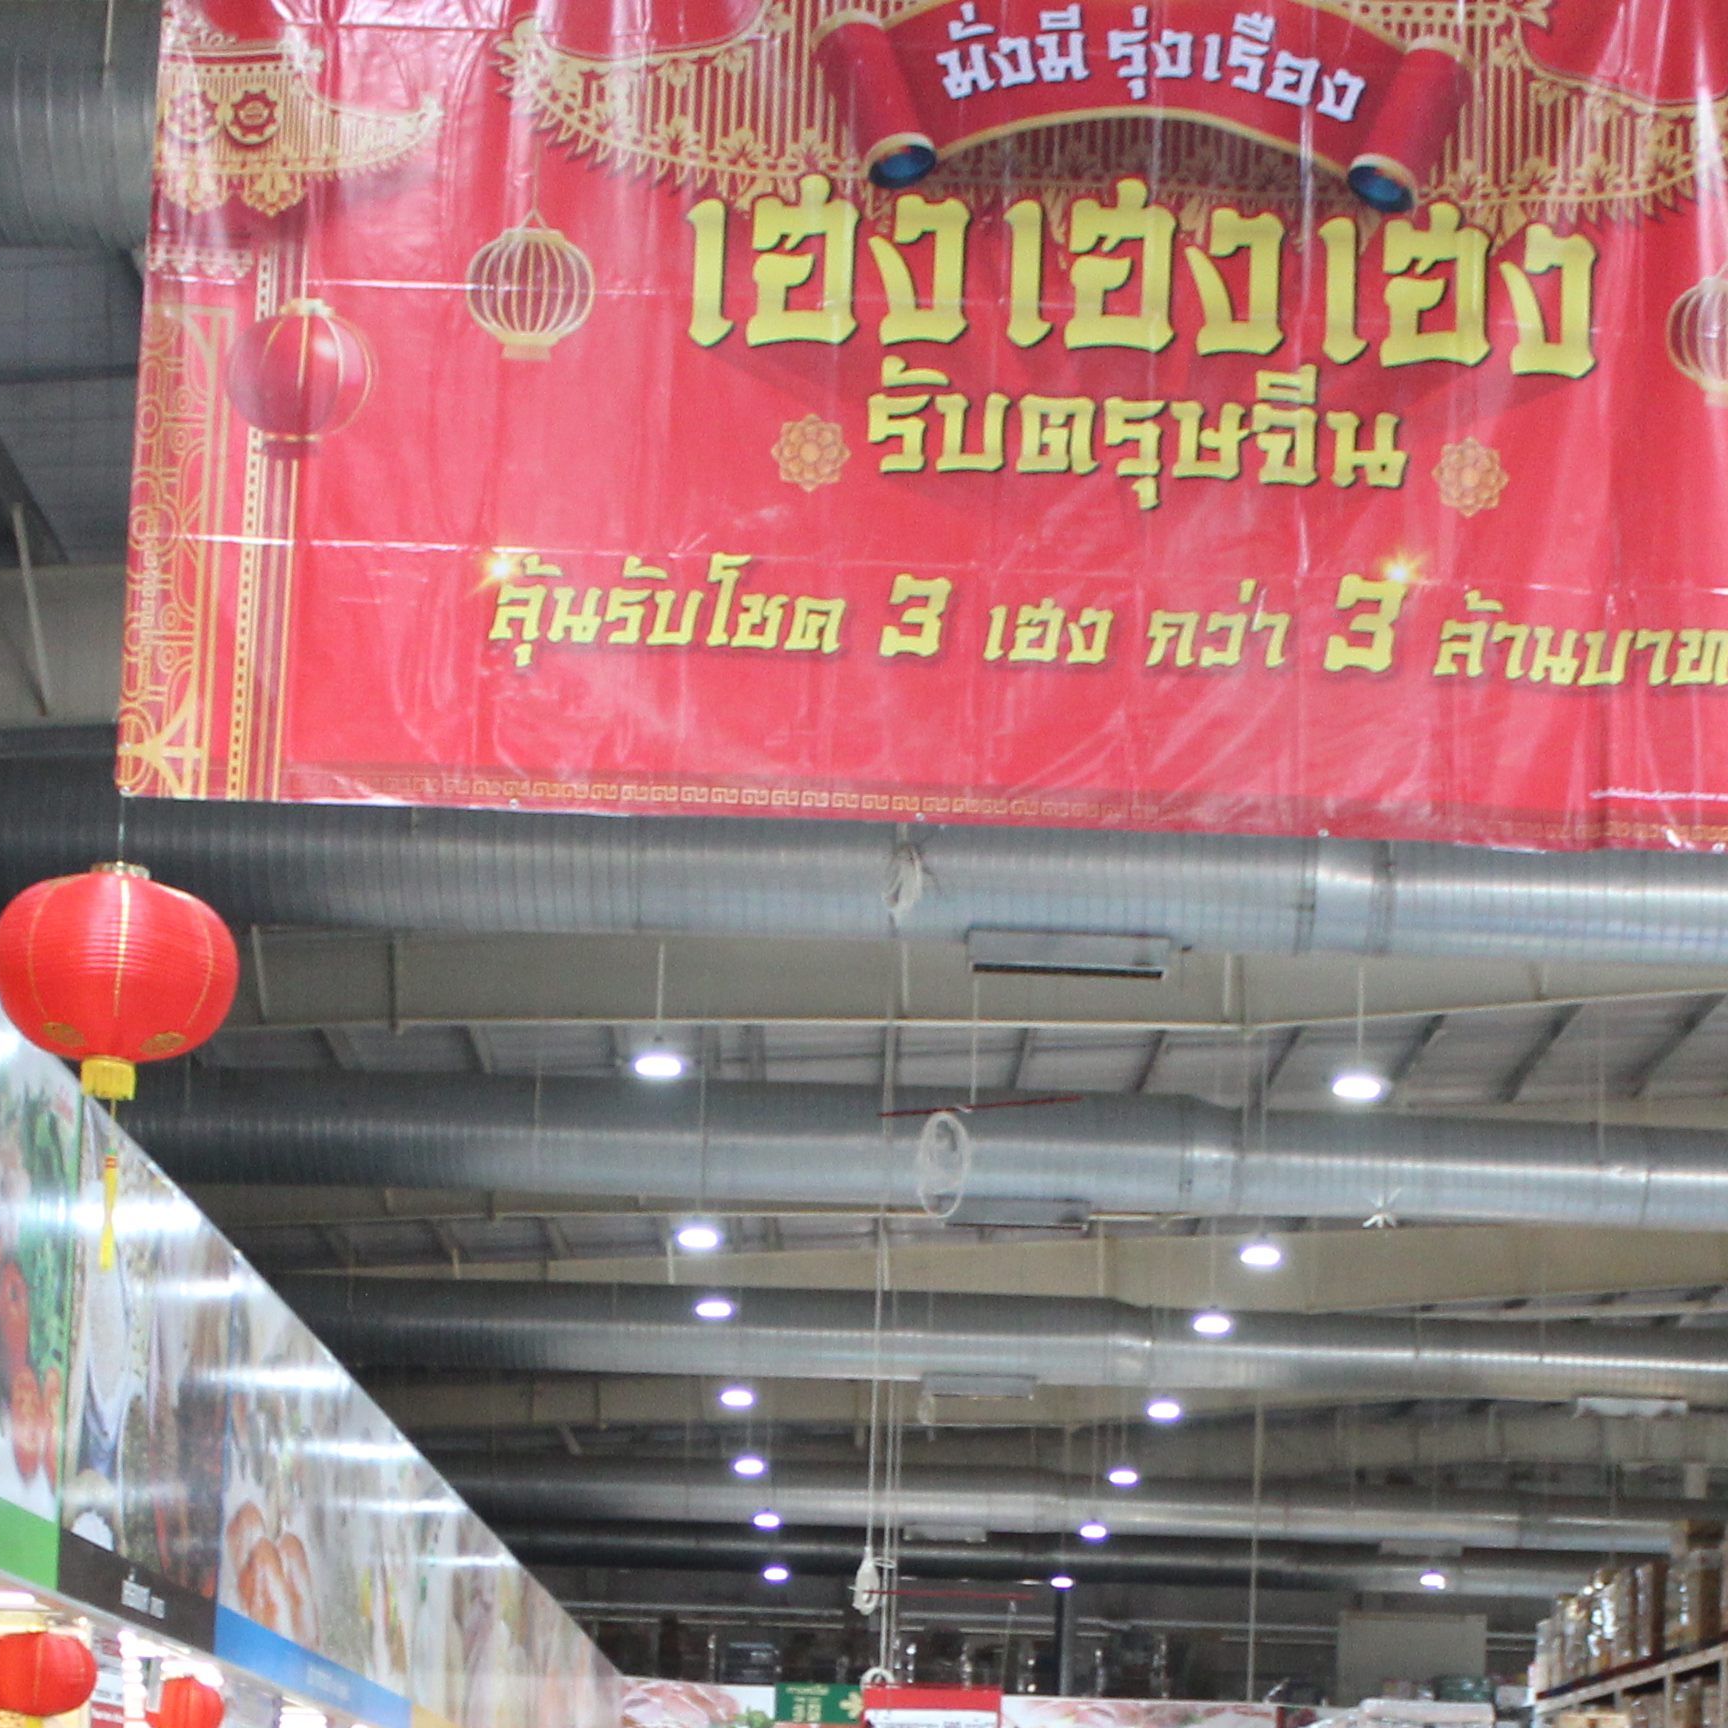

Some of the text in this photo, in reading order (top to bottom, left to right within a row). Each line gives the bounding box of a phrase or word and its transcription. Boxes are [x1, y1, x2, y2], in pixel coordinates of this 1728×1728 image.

[936, 2, 1366, 122] มั่งมี รุ่งเรือง
[866, 355, 1408, 509] รับตรุษจีน
[488, 553, 846, 667] ลุ้นรับโชค
[879, 574, 952, 657] 3
[982, 598, 1113, 664] เฮง
[1145, 579, 1289, 668] กว่า
[1323, 574, 1407, 672] 3
